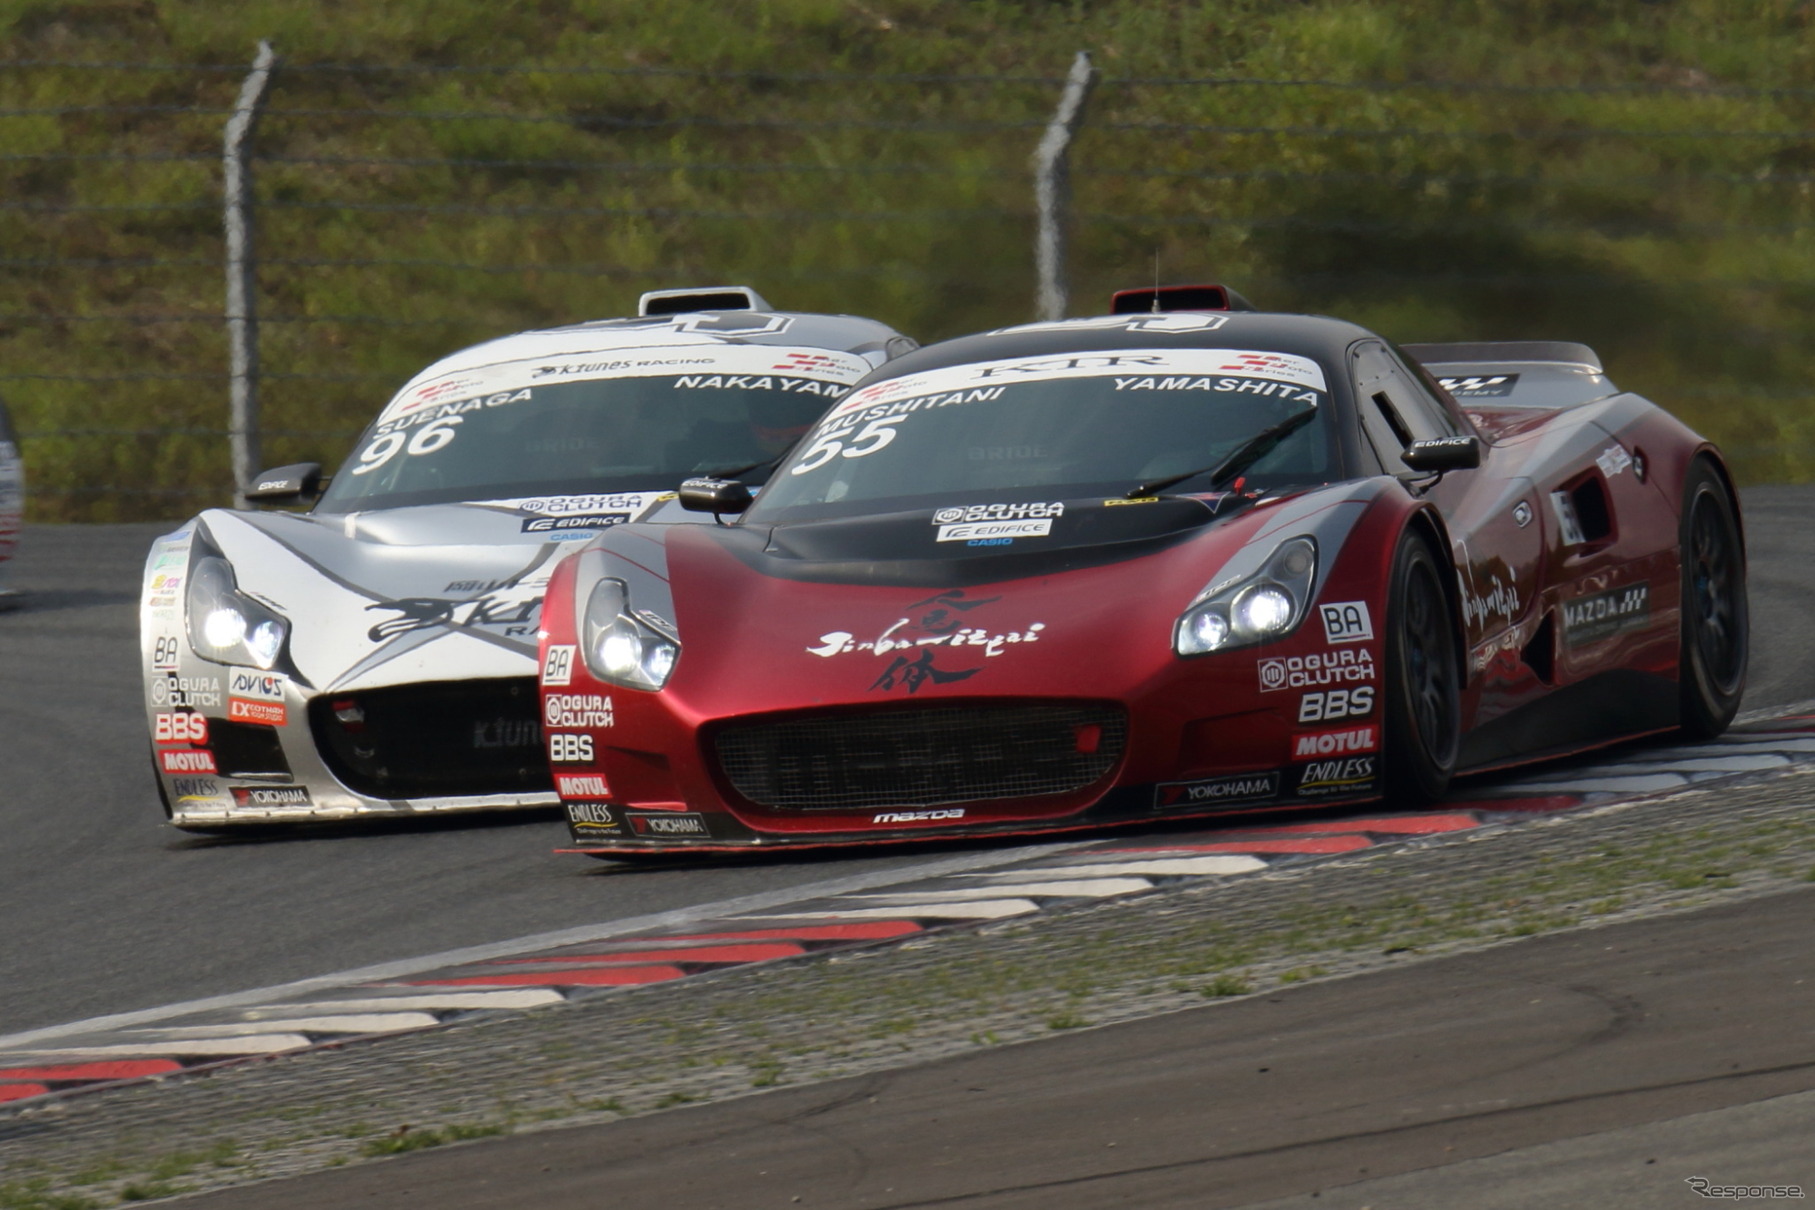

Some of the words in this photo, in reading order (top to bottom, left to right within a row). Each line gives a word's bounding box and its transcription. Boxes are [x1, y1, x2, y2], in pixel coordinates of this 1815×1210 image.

[636, 357, 716, 367] RACING
[1113, 376, 1318, 408] YAMASHITA
[372, 387, 533, 440] SUENAGA
[813, 386, 1007, 440] MUSHITANI
[351, 414, 465, 476] 96
[790, 413, 909, 476] 55
[1413, 436, 1472, 448] EDIFICE
[547, 499, 642, 513] CLUTCH
[549, 494, 642, 504] OGURA
[968, 501, 1065, 513] OGURA
[556, 515, 626, 529] EDIFICE
[964, 507, 1064, 521] CLUTCH
[550, 532, 594, 542] CASIO
[974, 523, 1046, 536] EDIFICE
[967, 537, 1014, 547] CASIO
[1322, 604, 1363, 636] BA
[1564, 596, 1619, 628] MAZDA
[153, 636, 178, 664] BA
[1286, 647, 1374, 672] OGURA
[544, 648, 570, 678] BA
[168, 676, 221, 691] OGURA
[1288, 663, 1376, 688] CLUTCH
[168, 692, 222, 707] CLUTCH
[561, 695, 613, 711] OGURA
[1298, 685, 1376, 723] BBS
[155, 711, 207, 743] BBS
[561, 711, 614, 728] CLUTCH
[550, 733, 595, 762] BBS
[1295, 727, 1375, 757] MOTUL
[163, 752, 215, 772] MOTUL
[1299, 756, 1376, 784] ENDLESS
[172, 777, 219, 797] ENDLESS
[558, 776, 609, 796] MOTUL
[1187, 778, 1271, 800] YOKOHAMA
[249, 789, 308, 805] YOKOHAMA
[567, 803, 613, 823] ENDLESS
[646, 817, 704, 833] YOKOHAMA
